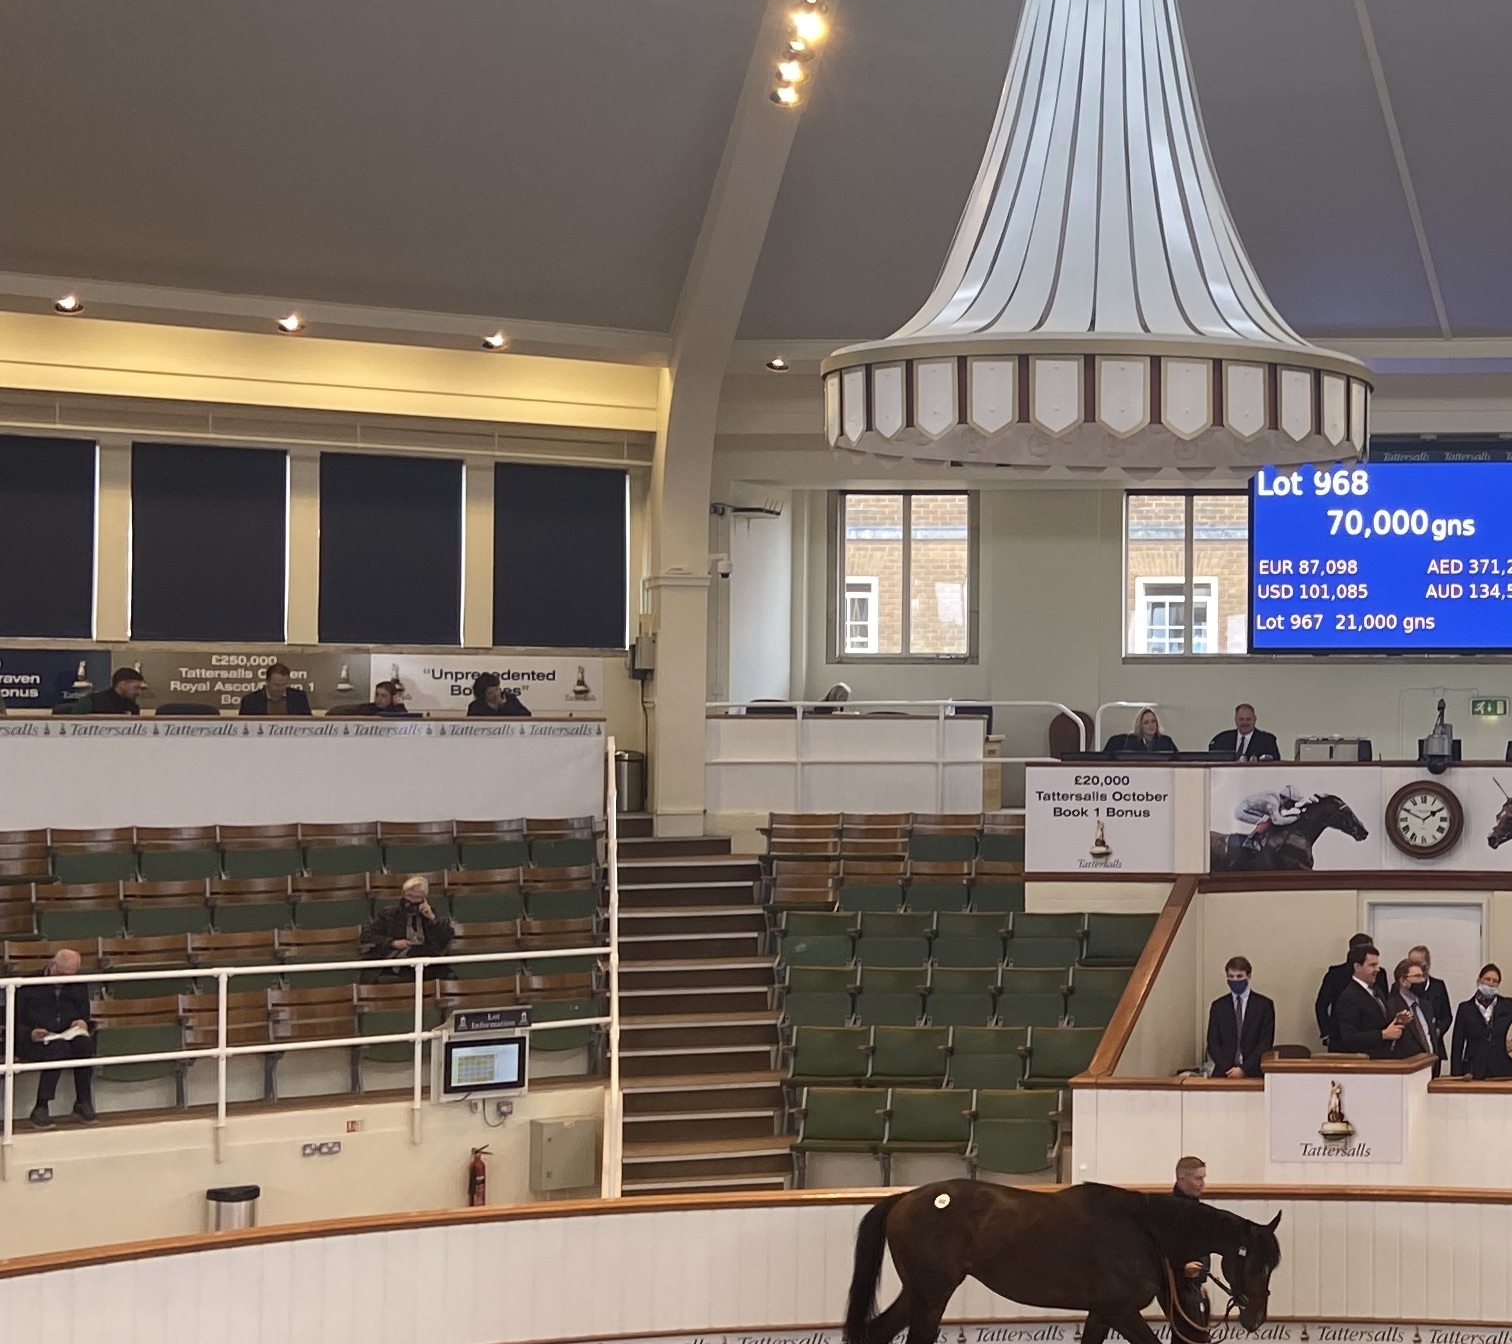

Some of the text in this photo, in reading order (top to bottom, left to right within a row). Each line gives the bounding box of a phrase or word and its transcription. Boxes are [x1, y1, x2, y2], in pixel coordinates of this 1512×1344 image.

[1258, 470, 1369, 496] Lot 968
[1327, 509, 1475, 541] 70,000 gns
[1259, 559, 1358, 576] EUR 87,098
[1426, 559, 1464, 574] AED
[1257, 584, 1368, 601] USD 101,085
[1425, 583, 1464, 599] AUD
[1256, 614, 1435, 633] Lot 967 21,000 gns
[0, 675, 40, 684] raven
[178, 667, 253, 679] Tattersalls
[0, 688, 39, 698] onus
[170, 681, 210, 693] Royal
[71, 722, 148, 737] Tattersalls
[163, 723, 239, 737] Tattersalls
[268, 723, 339, 737] Tattersalls
[353, 723, 423, 737] Tattersalls
[450, 724, 516, 737] Tattersalls
[529, 724, 593, 737] Tattersalls
[1074, 775, 1130, 787] £20,000
[1036, 791, 1168, 802] Tattersalls October
[1053, 807, 1151, 818] Book 1 Bonus
[1300, 1142, 1372, 1158] Tattersalls
[975, 1325, 1065, 1344] Tattersalls
[1210, 1323, 1292, 1341] attersalls
[1317, 1325, 1404, 1344] Tattersalls
